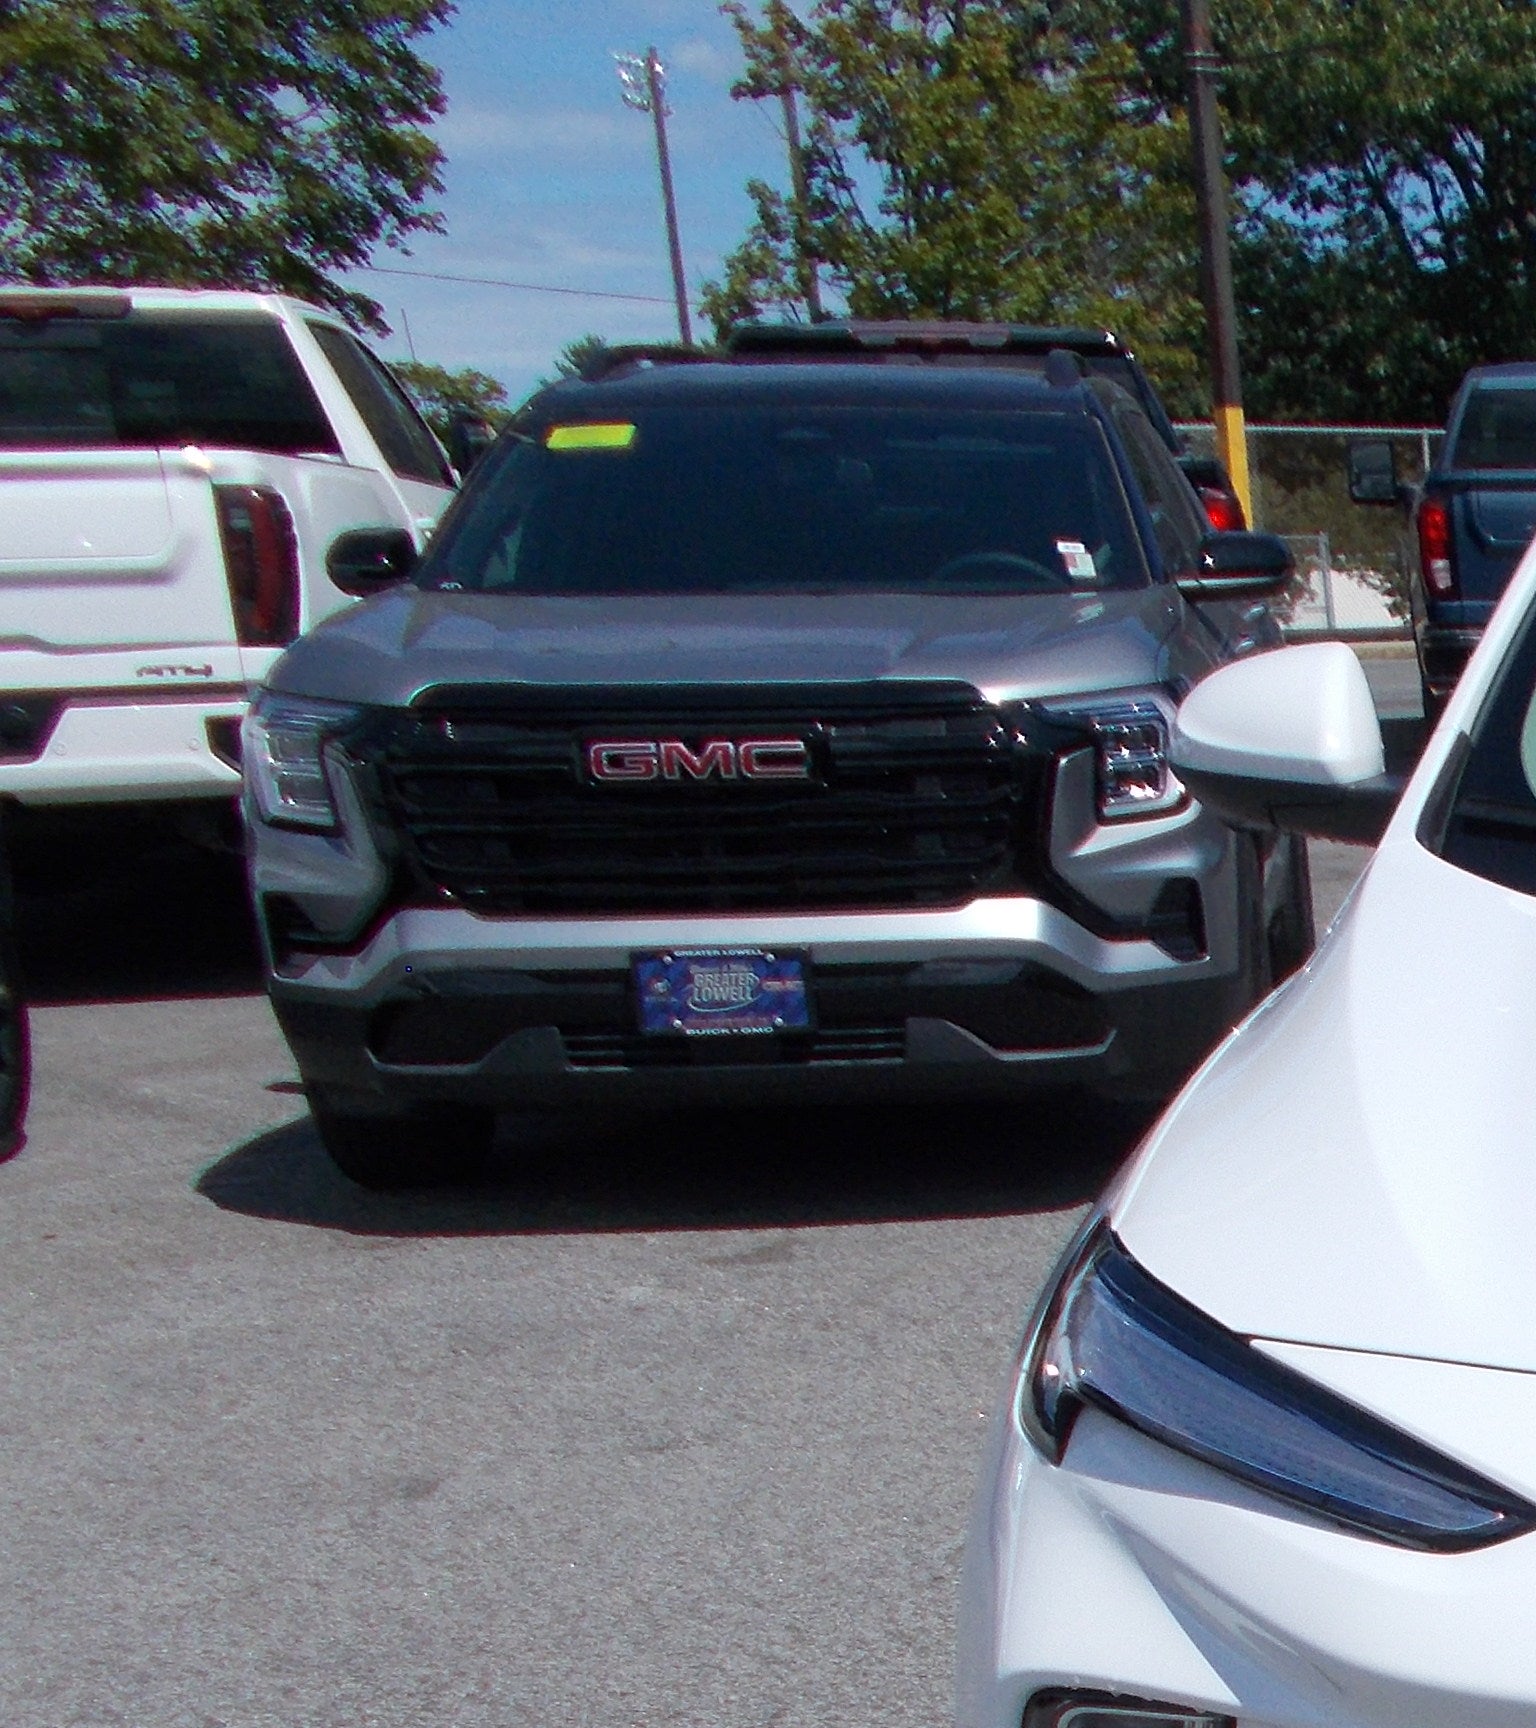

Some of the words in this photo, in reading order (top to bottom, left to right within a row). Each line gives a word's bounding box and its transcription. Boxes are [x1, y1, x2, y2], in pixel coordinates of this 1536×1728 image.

[590, 741, 809, 780] GMC
[693, 972, 756, 987] GREATER
[692, 986, 756, 1001] LOWELL
